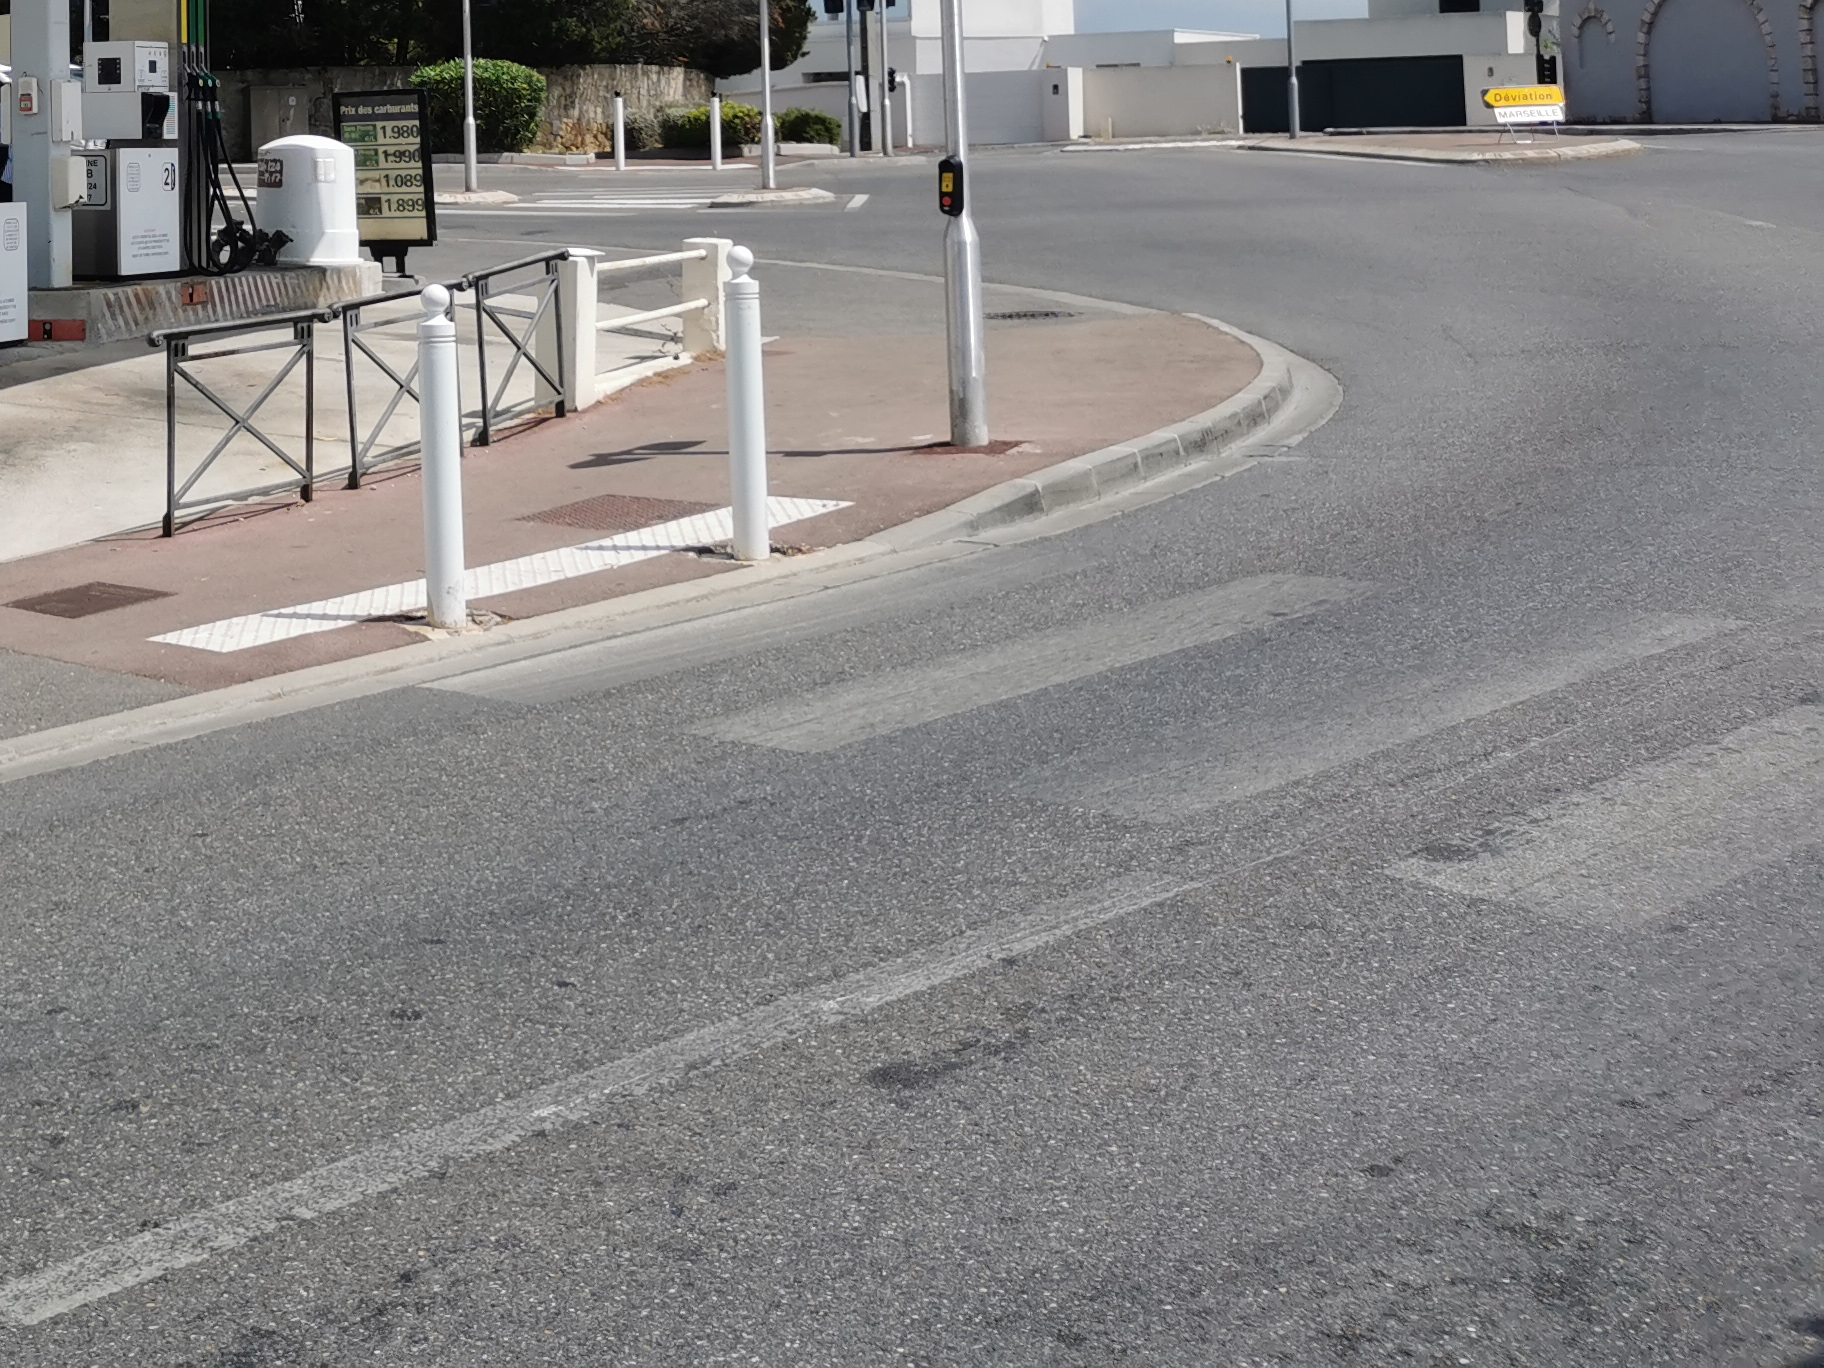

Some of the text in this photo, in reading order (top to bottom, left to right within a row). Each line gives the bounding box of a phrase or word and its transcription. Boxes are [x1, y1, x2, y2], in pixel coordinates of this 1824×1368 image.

[1493, 91, 1553, 103] Déviation
[340, 102, 419, 115] Prix des carburants
[1498, 108, 1560, 119] MARSEILLE
[379, 124, 420, 140] 1.980
[163, 167, 170, 186] 2
[383, 173, 424, 188] 1.089
[385, 197, 425, 212] 1.899
